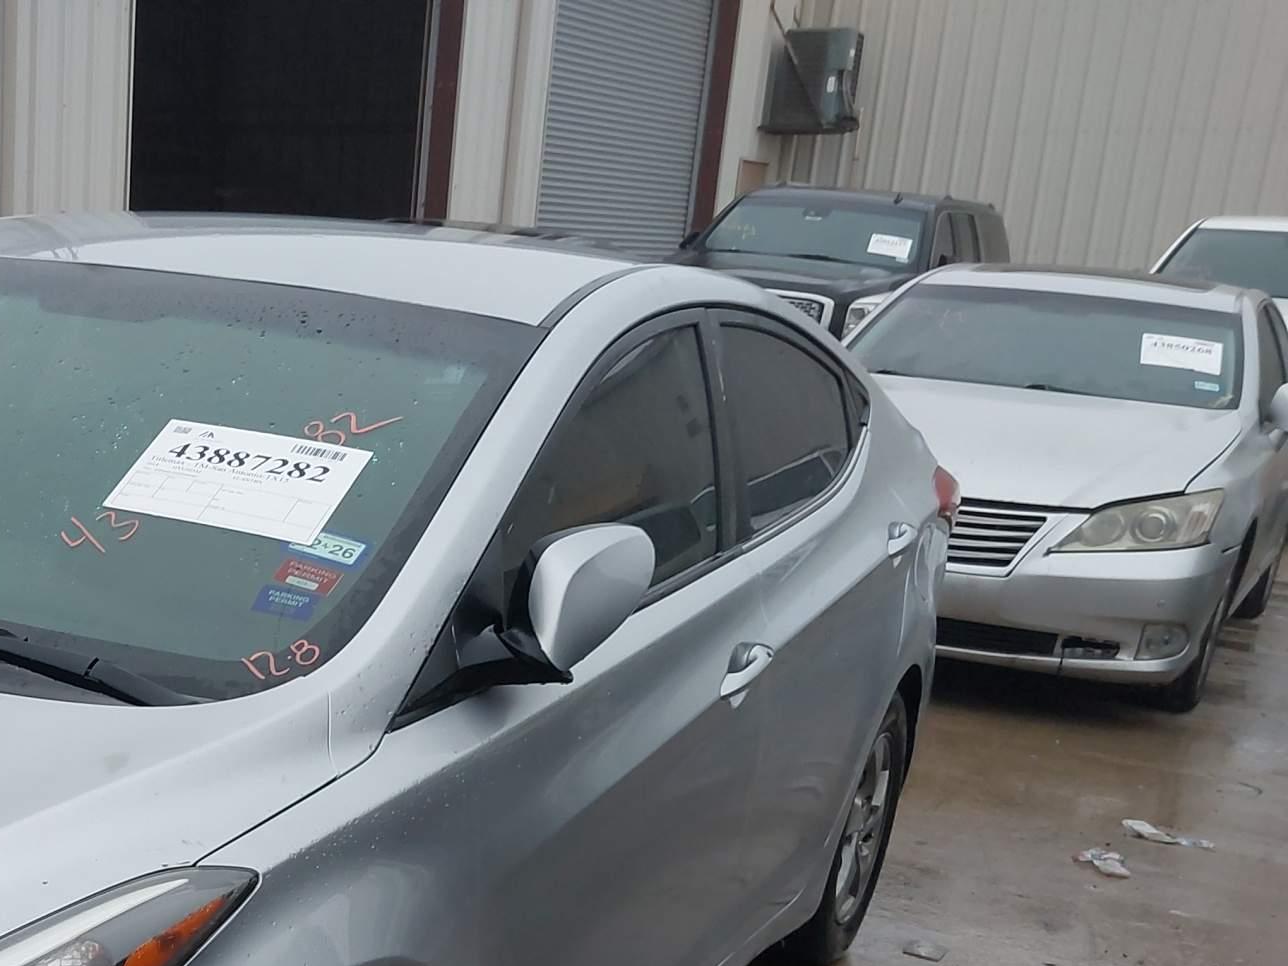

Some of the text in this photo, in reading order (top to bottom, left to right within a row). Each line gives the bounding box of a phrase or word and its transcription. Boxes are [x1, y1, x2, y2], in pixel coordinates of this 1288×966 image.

[169, 442, 331, 483] 43887282
[60, 511, 140, 553] 43
[287, 568, 329, 584] PERMIT
[289, 561, 337, 580] PARKING
[268, 590, 310, 603] PARKING
[268, 596, 305, 608] PERMIT
